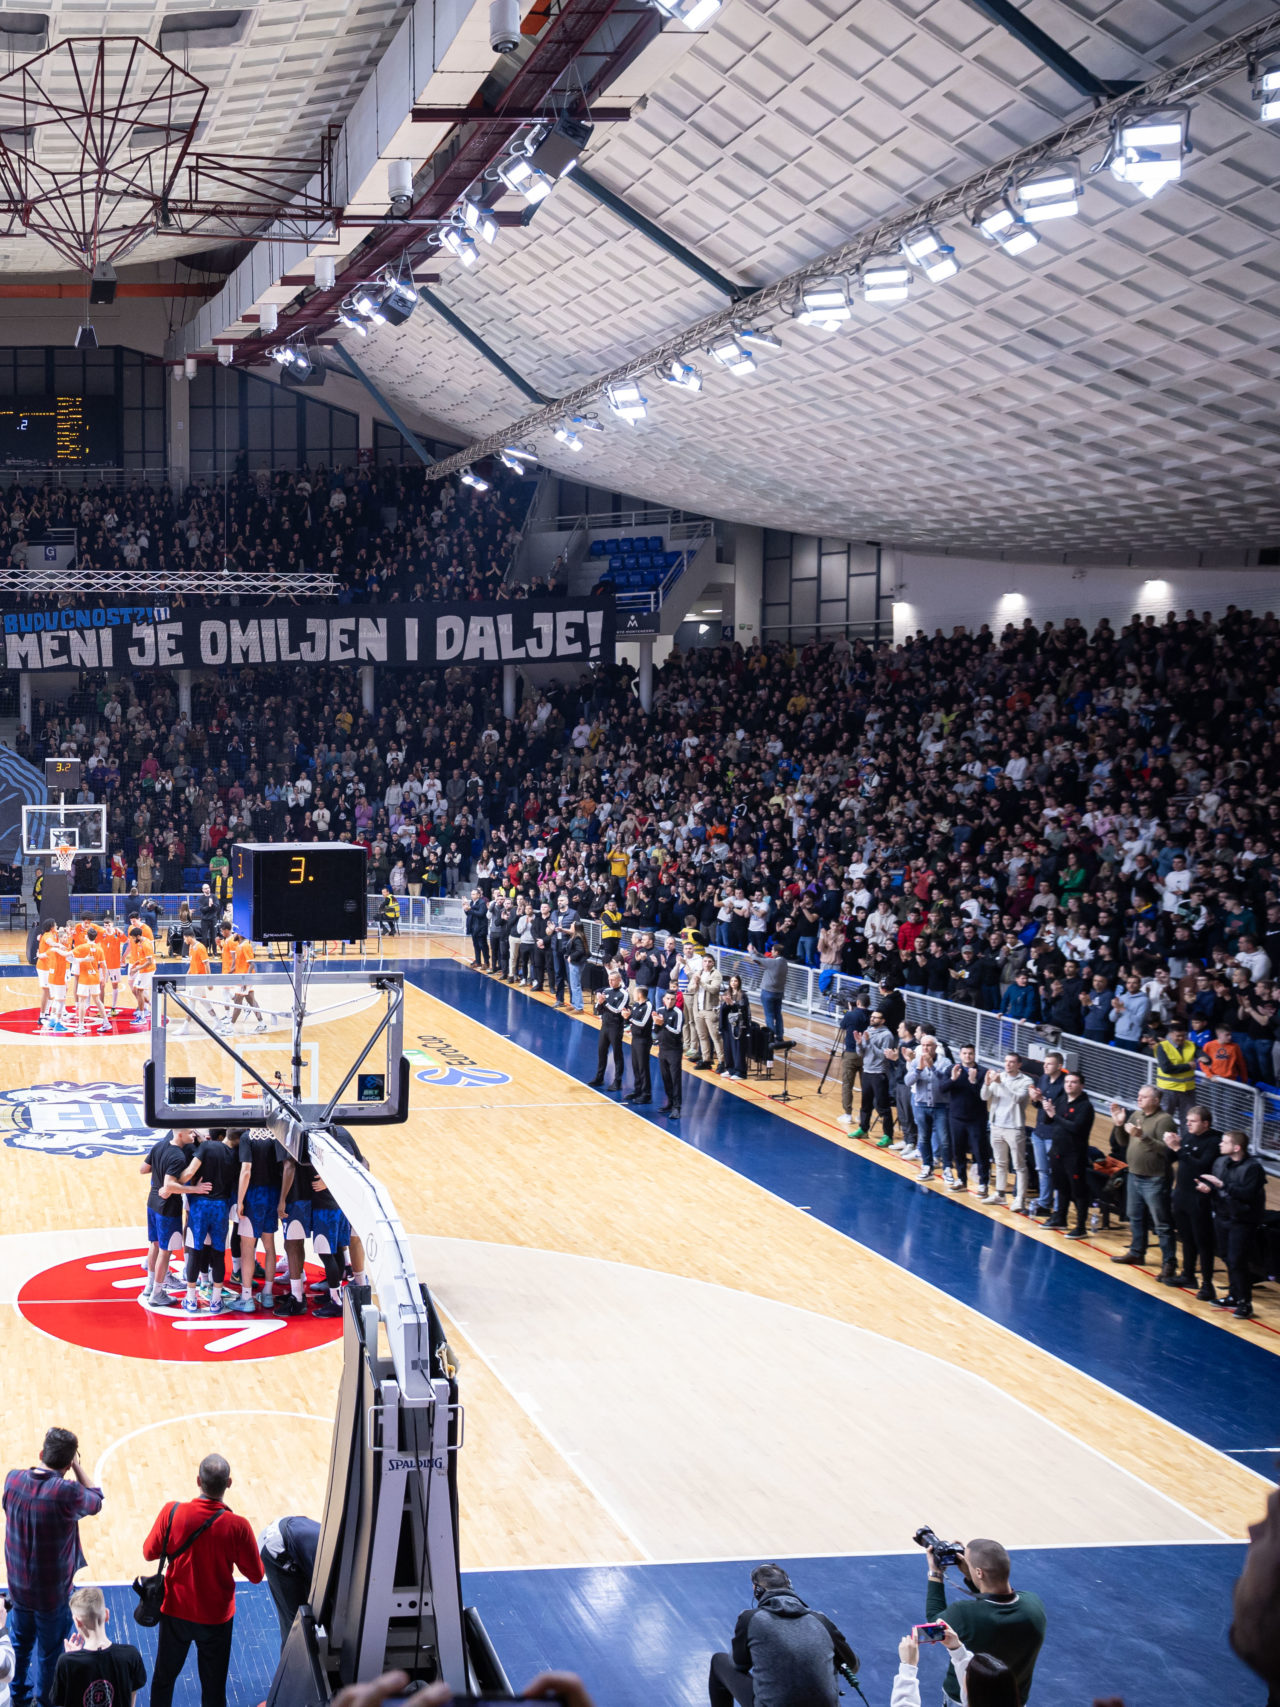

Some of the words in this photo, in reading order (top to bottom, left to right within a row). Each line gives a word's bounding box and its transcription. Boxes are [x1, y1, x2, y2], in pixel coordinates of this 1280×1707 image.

[46, 547, 55, 556] G
[5, 627, 113, 669] MENI
[128, 622, 184, 667] JE
[200, 617, 387, 665] OMILJEN
[405, 617, 419, 661] I
[436, 610, 603, 661] DALJE!
[55, 762, 72, 773] 3.2
[417, 1035, 477, 1066] EuroCup
[388, 1457, 443, 1471] SPALDING
